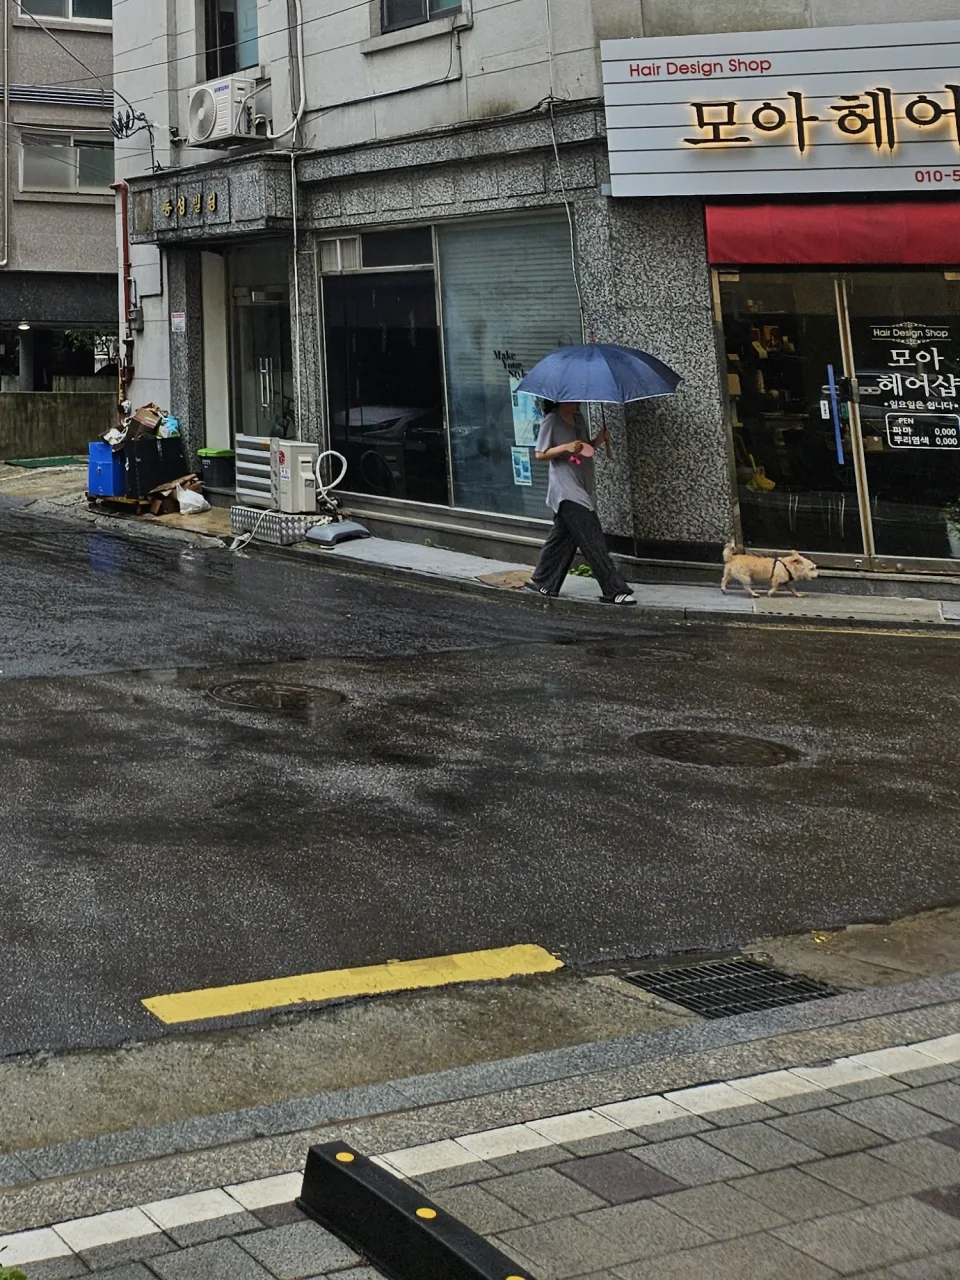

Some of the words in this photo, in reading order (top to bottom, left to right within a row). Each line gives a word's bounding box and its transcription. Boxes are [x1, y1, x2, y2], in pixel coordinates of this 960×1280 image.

[629, 62, 661, 77] Hair
[666, 60, 723, 77] Design
[728, 58, 772, 73] Shop
[873, 328, 891, 337] Hair
[892, 328, 923, 338] Design
[925, 328, 948, 338] Shop
[493, 349, 516, 361] Make
[887, 347, 944, 371] 모아
[501, 359, 522, 370] Your
[876, 373, 960, 397] 헤어샵
[889, 400, 925, 410] 일요일은
[892, 427, 912, 435] 파마
[893, 436, 929, 445] 뿌리염색
